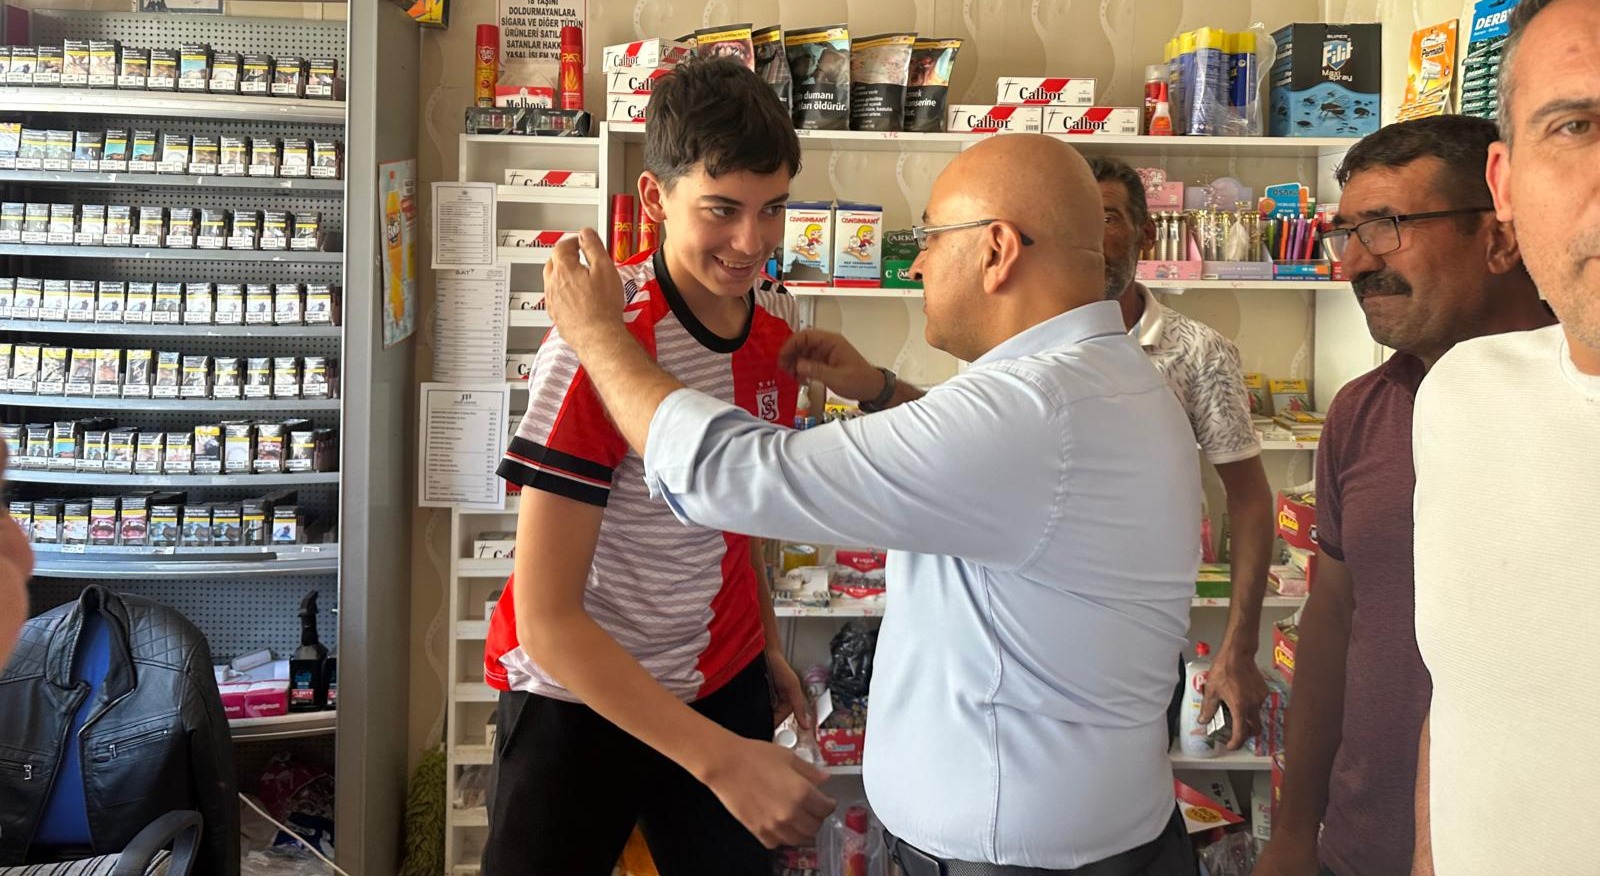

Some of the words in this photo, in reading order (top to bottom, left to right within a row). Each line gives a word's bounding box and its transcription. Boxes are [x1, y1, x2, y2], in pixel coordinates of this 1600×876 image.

[508, 7, 576, 17] DOLDURMAYANLARA
[501, 16, 526, 26] SİGARA
[527, 18, 537, 27] VE
[538, 18, 559, 27] DİĞER
[505, 27, 538, 38] ÜRÜNLERİ
[506, 40, 541, 49] SATANLAR
[613, 54, 640, 68] Calbor
[1019, 86, 1064, 101] Calbor
[813, 101, 848, 111] öldürür.
[967, 115, 1012, 130] Calbor
[1063, 116, 1108, 132] Calbor
